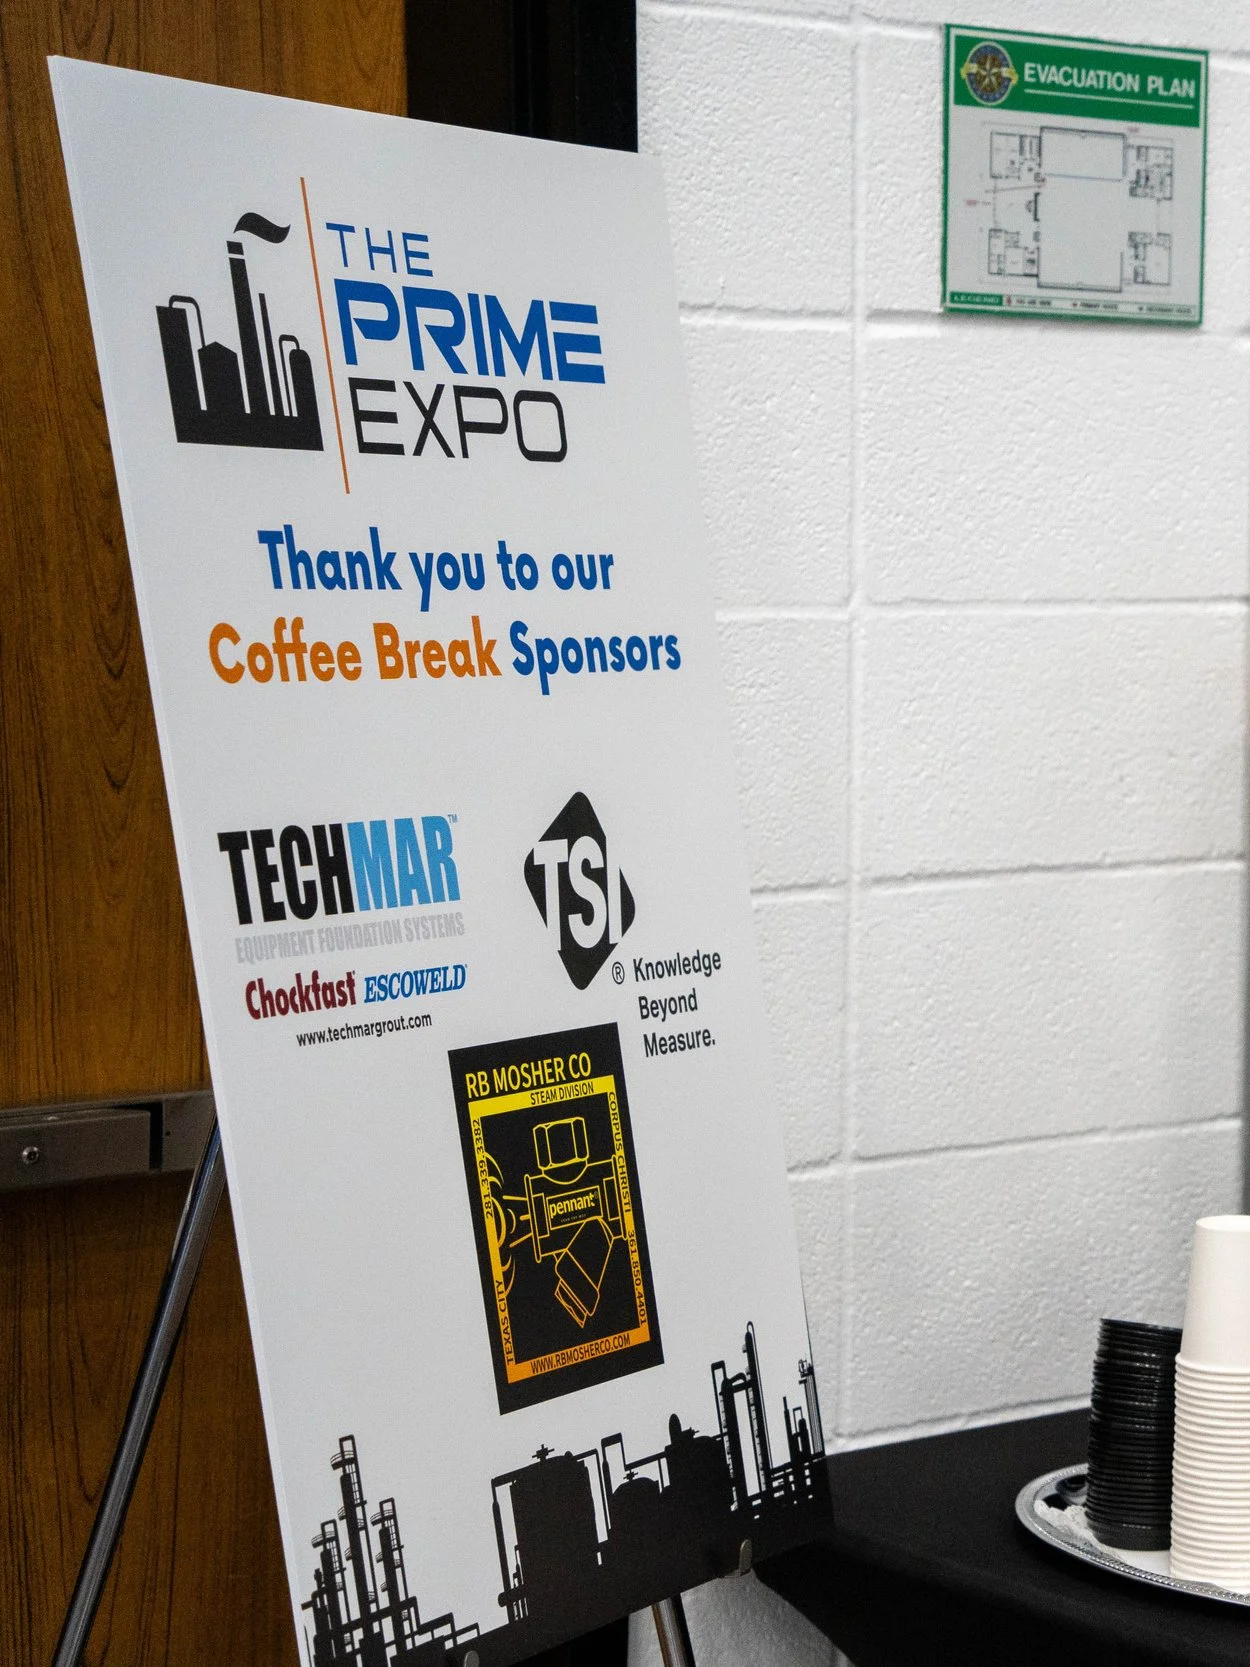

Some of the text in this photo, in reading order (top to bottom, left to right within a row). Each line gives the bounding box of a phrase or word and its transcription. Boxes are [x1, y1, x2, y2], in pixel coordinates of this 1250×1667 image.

[1023, 62, 1140, 93] EVACUATION
[1147, 75, 1195, 98] PLAN
[326, 222, 433, 277] THE
[334, 278, 606, 384] PRIME
[348, 377, 567, 462] EXPO
[258, 524, 614, 612] Thank you to our
[208, 615, 681, 696] Coffee Break Sponsors
[533, 835, 623, 951] TSI
[234, 912, 466, 965] EQUIPMENT FOUNDATION SYSTEMS
[245, 964, 467, 1020] Chockfast ESCOWELD
[632, 949, 722, 982] Knowledge
[296, 1012, 432, 1047] www.techmargrout.com
[638, 987, 698, 1022] Beyond
[643, 1028, 716, 1058] Measure.
[465, 1052, 592, 1099] RB MOSHER CO
[530, 1081, 594, 1106] STEAM DIVISION
[608, 1091, 632, 1213] CORPUS CHRISTI
[549, 1191, 596, 1219] pennant
[496, 1279, 515, 1365] TEXAS CITY
[530, 1333, 631, 1375] WWW.RBMOSHERCO.COM
